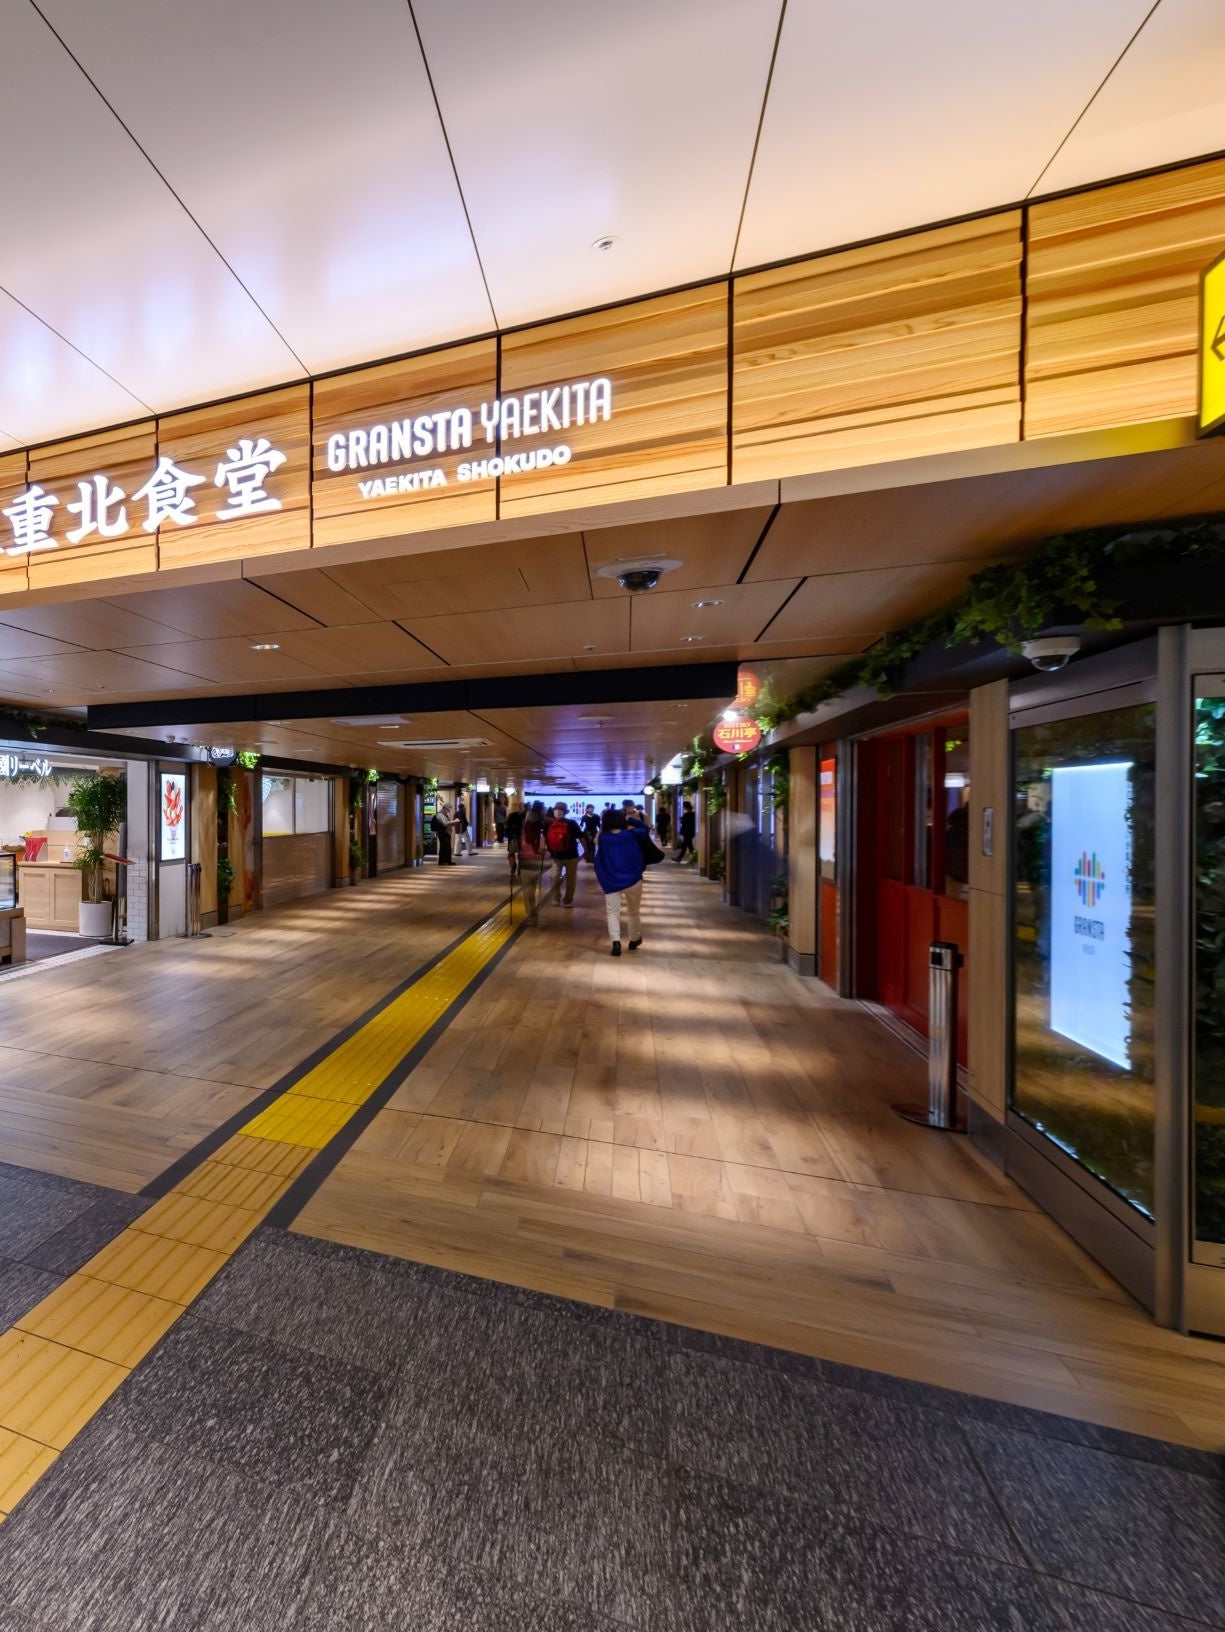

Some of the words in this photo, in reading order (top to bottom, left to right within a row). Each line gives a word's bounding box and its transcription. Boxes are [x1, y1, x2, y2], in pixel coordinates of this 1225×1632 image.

[327, 407, 472, 472] GRANSTA
[480, 378, 612, 443] YAEKITA
[357, 469, 449, 499] YAEKITA
[456, 445, 572, 482] SHOKUDO
[718, 727, 757, 739] 石川亭
